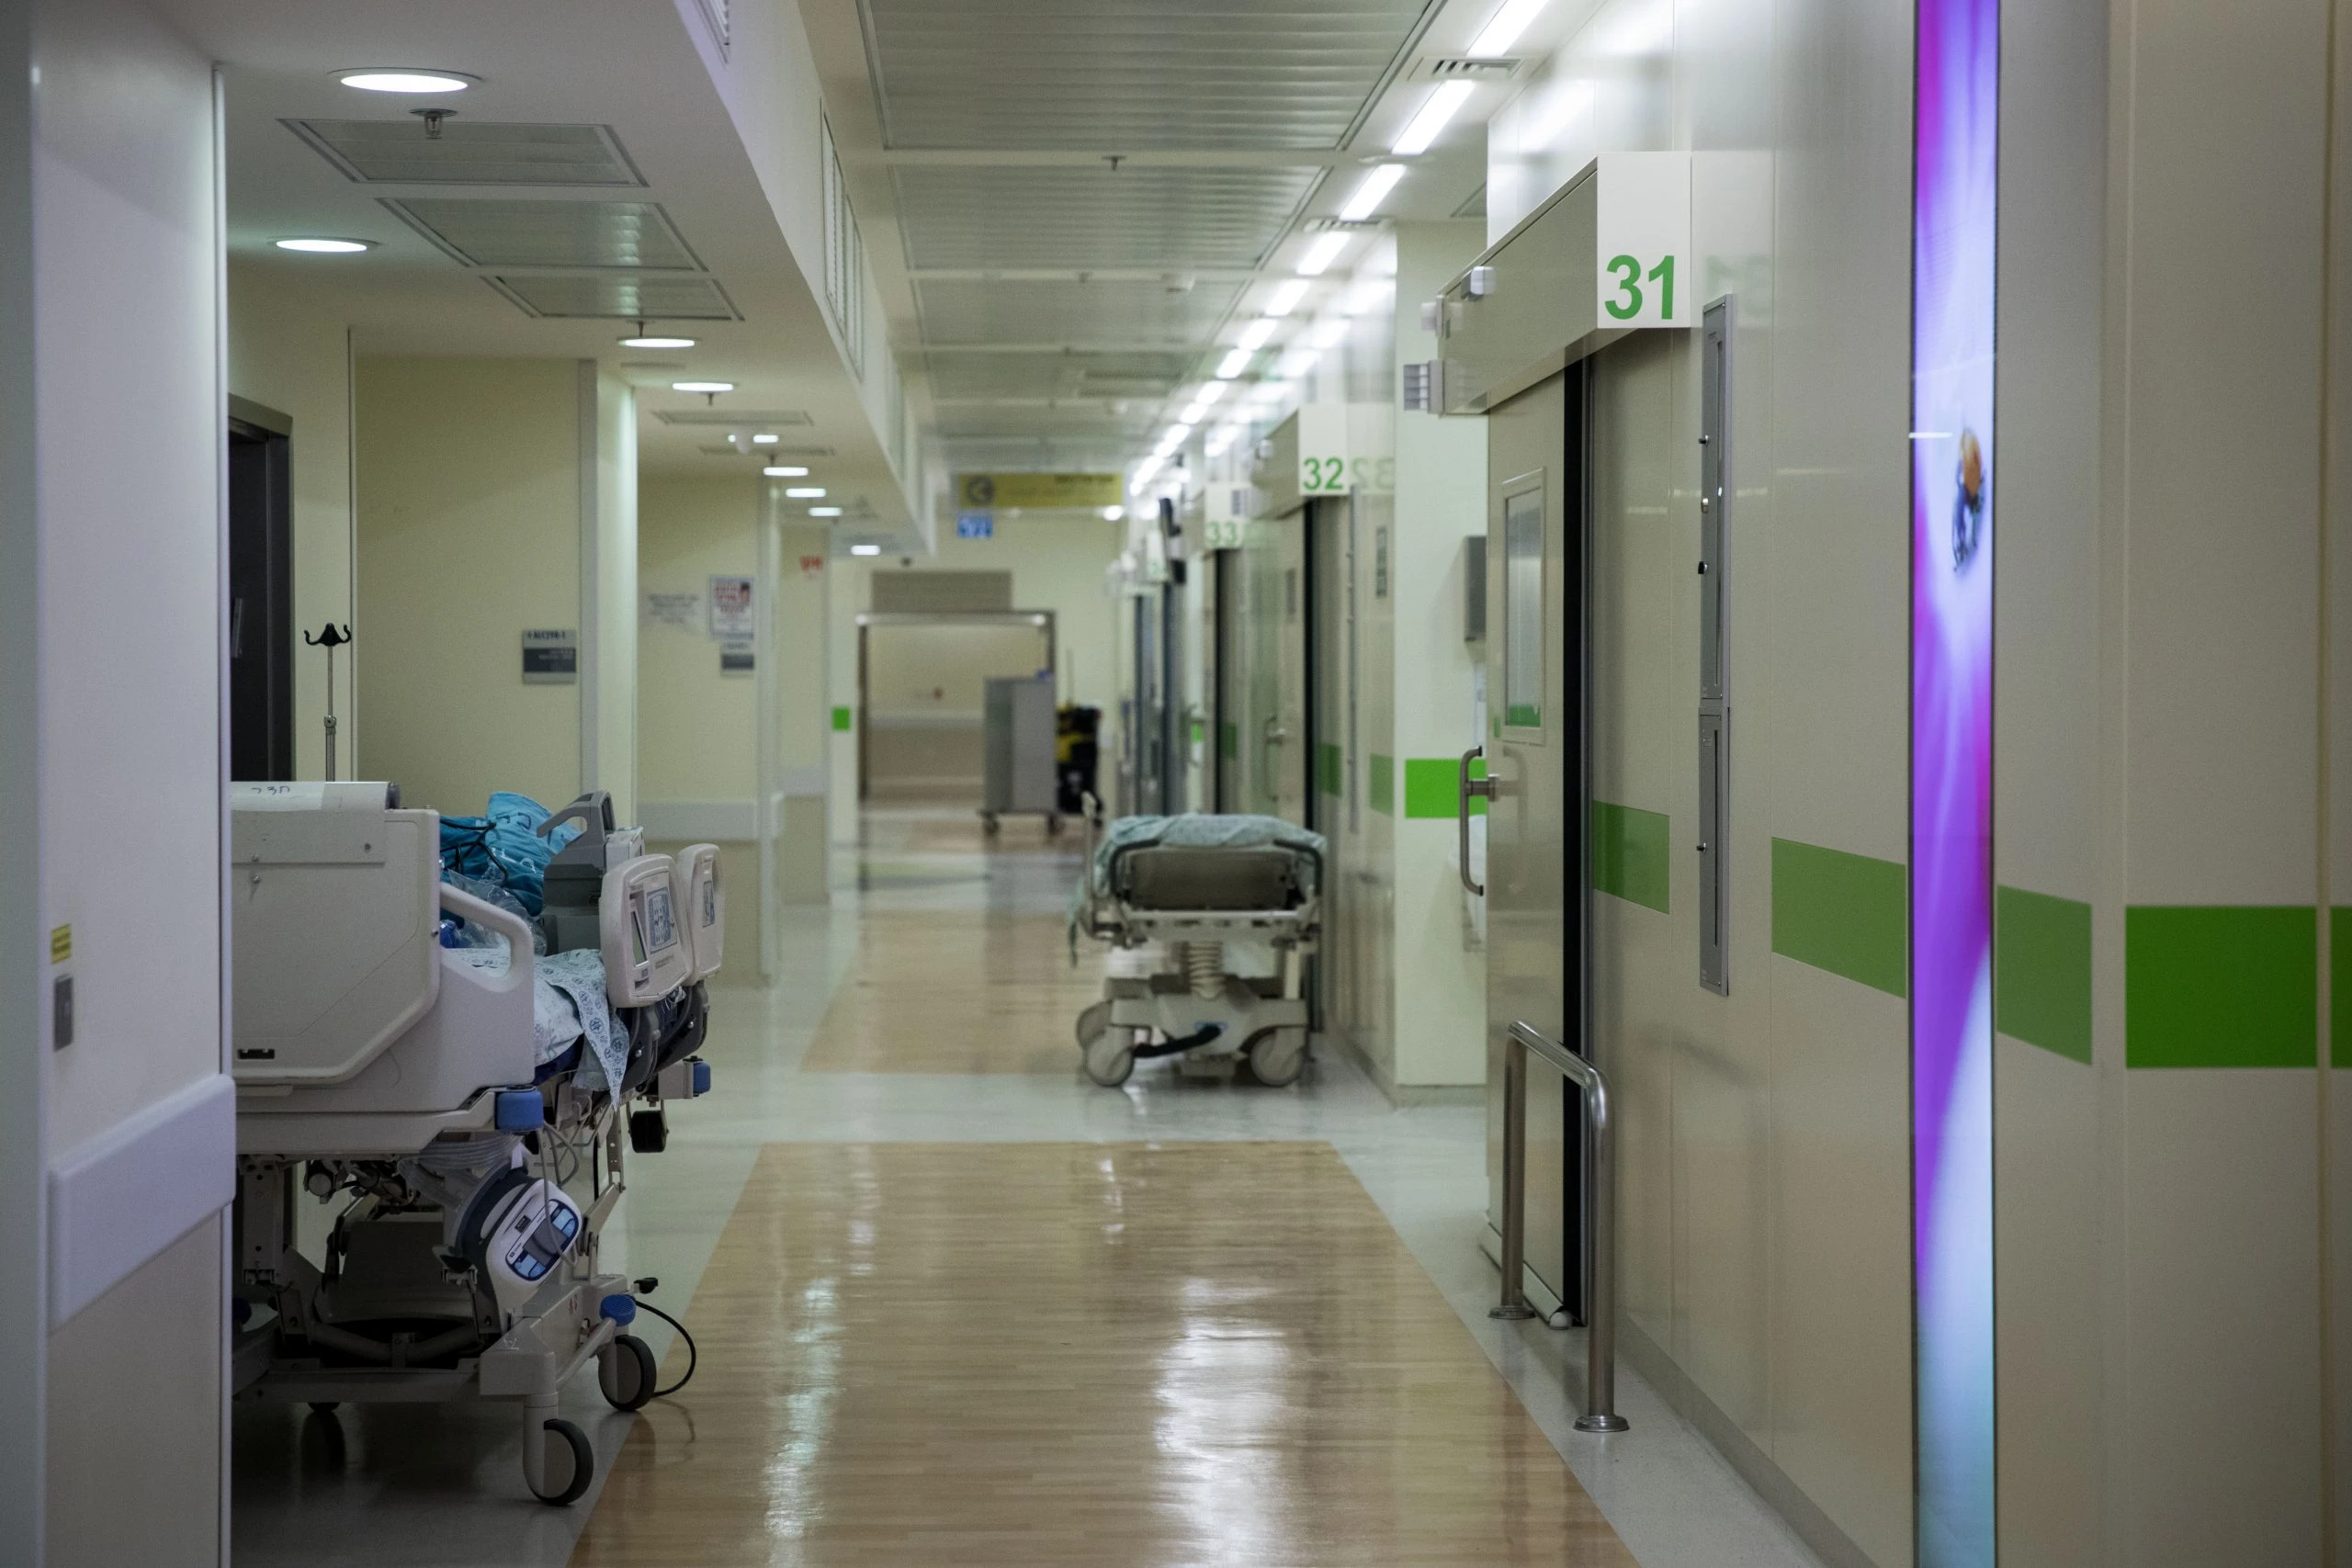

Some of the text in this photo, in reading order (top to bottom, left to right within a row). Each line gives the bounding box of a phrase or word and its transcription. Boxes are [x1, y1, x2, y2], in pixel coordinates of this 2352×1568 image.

[1604, 254, 1675, 321] 31
[1303, 457, 1343, 491] 32
[1205, 521, 1238, 547] 33
